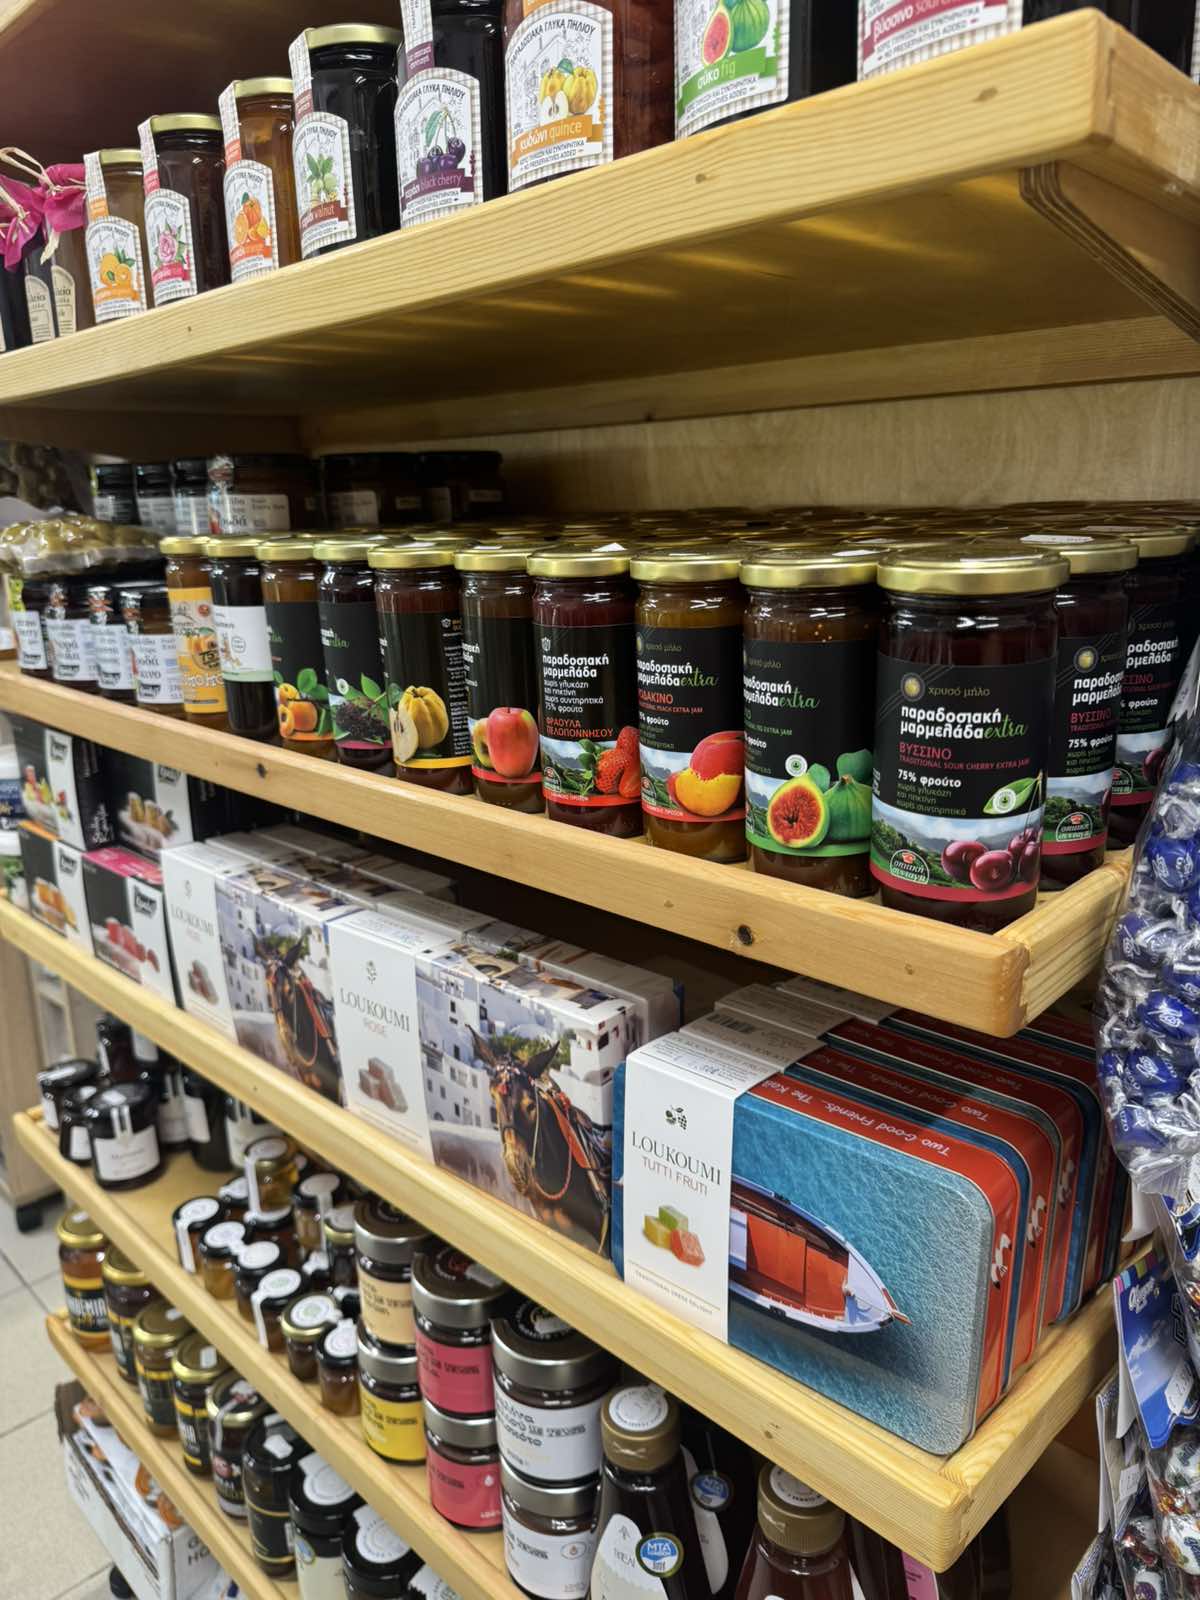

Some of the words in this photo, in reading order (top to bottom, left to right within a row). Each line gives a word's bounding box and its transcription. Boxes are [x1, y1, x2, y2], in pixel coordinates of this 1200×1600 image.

[544, 18, 567, 34] ΓΛΥΚΑ
[567, 19, 597, 35] ΠΗΛΙΟΥ
[549, 120, 584, 147] quince
[437, 171, 463, 188] cherry
[1126, 635, 1179, 657] ραδοσιακή
[543, 654, 609, 668] παραδοσιακή
[1125, 651, 1171, 669] ρμελάδα
[544, 665, 597, 680] μαρμελάδα
[680, 667, 719, 687] extra
[1073, 671, 1124, 692] παραδοσ
[1121, 673, 1153, 685] ΣΣΙΝΟ
[778, 686, 820, 709] extra
[929, 687, 962, 698] χρυσό
[963, 686, 991, 699] μήλο
[1128, 698, 1158, 710] φρούτο
[901, 706, 1002, 724] παραδοσιακή
[546, 724, 613, 738] ΠΕΛΟΠΟΝΝΗΣΟΥ
[900, 720, 984, 740] μαρμελάδα
[984, 714, 1029, 739] extra
[898, 741, 953, 761] ΒΥΣΣΙΝΟ
[1068, 738, 1088, 749] 75%
[899, 755, 942, 770] TRADITIONAL
[898, 768, 917, 783] 75%
[919, 776, 962, 789] φρούτο
[916, 803, 967, 817] συντηρητικά
[339, 986, 410, 1033] LOUKOUMI
[791, 1089, 813, 1105] The
[961, 1105, 989, 1122] Two
[875, 1121, 918, 1143] Good
[920, 1138, 950, 1157] Two
[632, 1130, 721, 1186] LOUKOUMI
[642, 1155, 673, 1180] TUTTI
[676, 1170, 709, 1197] FRUTI
[647, 1541, 673, 1552] MTA
